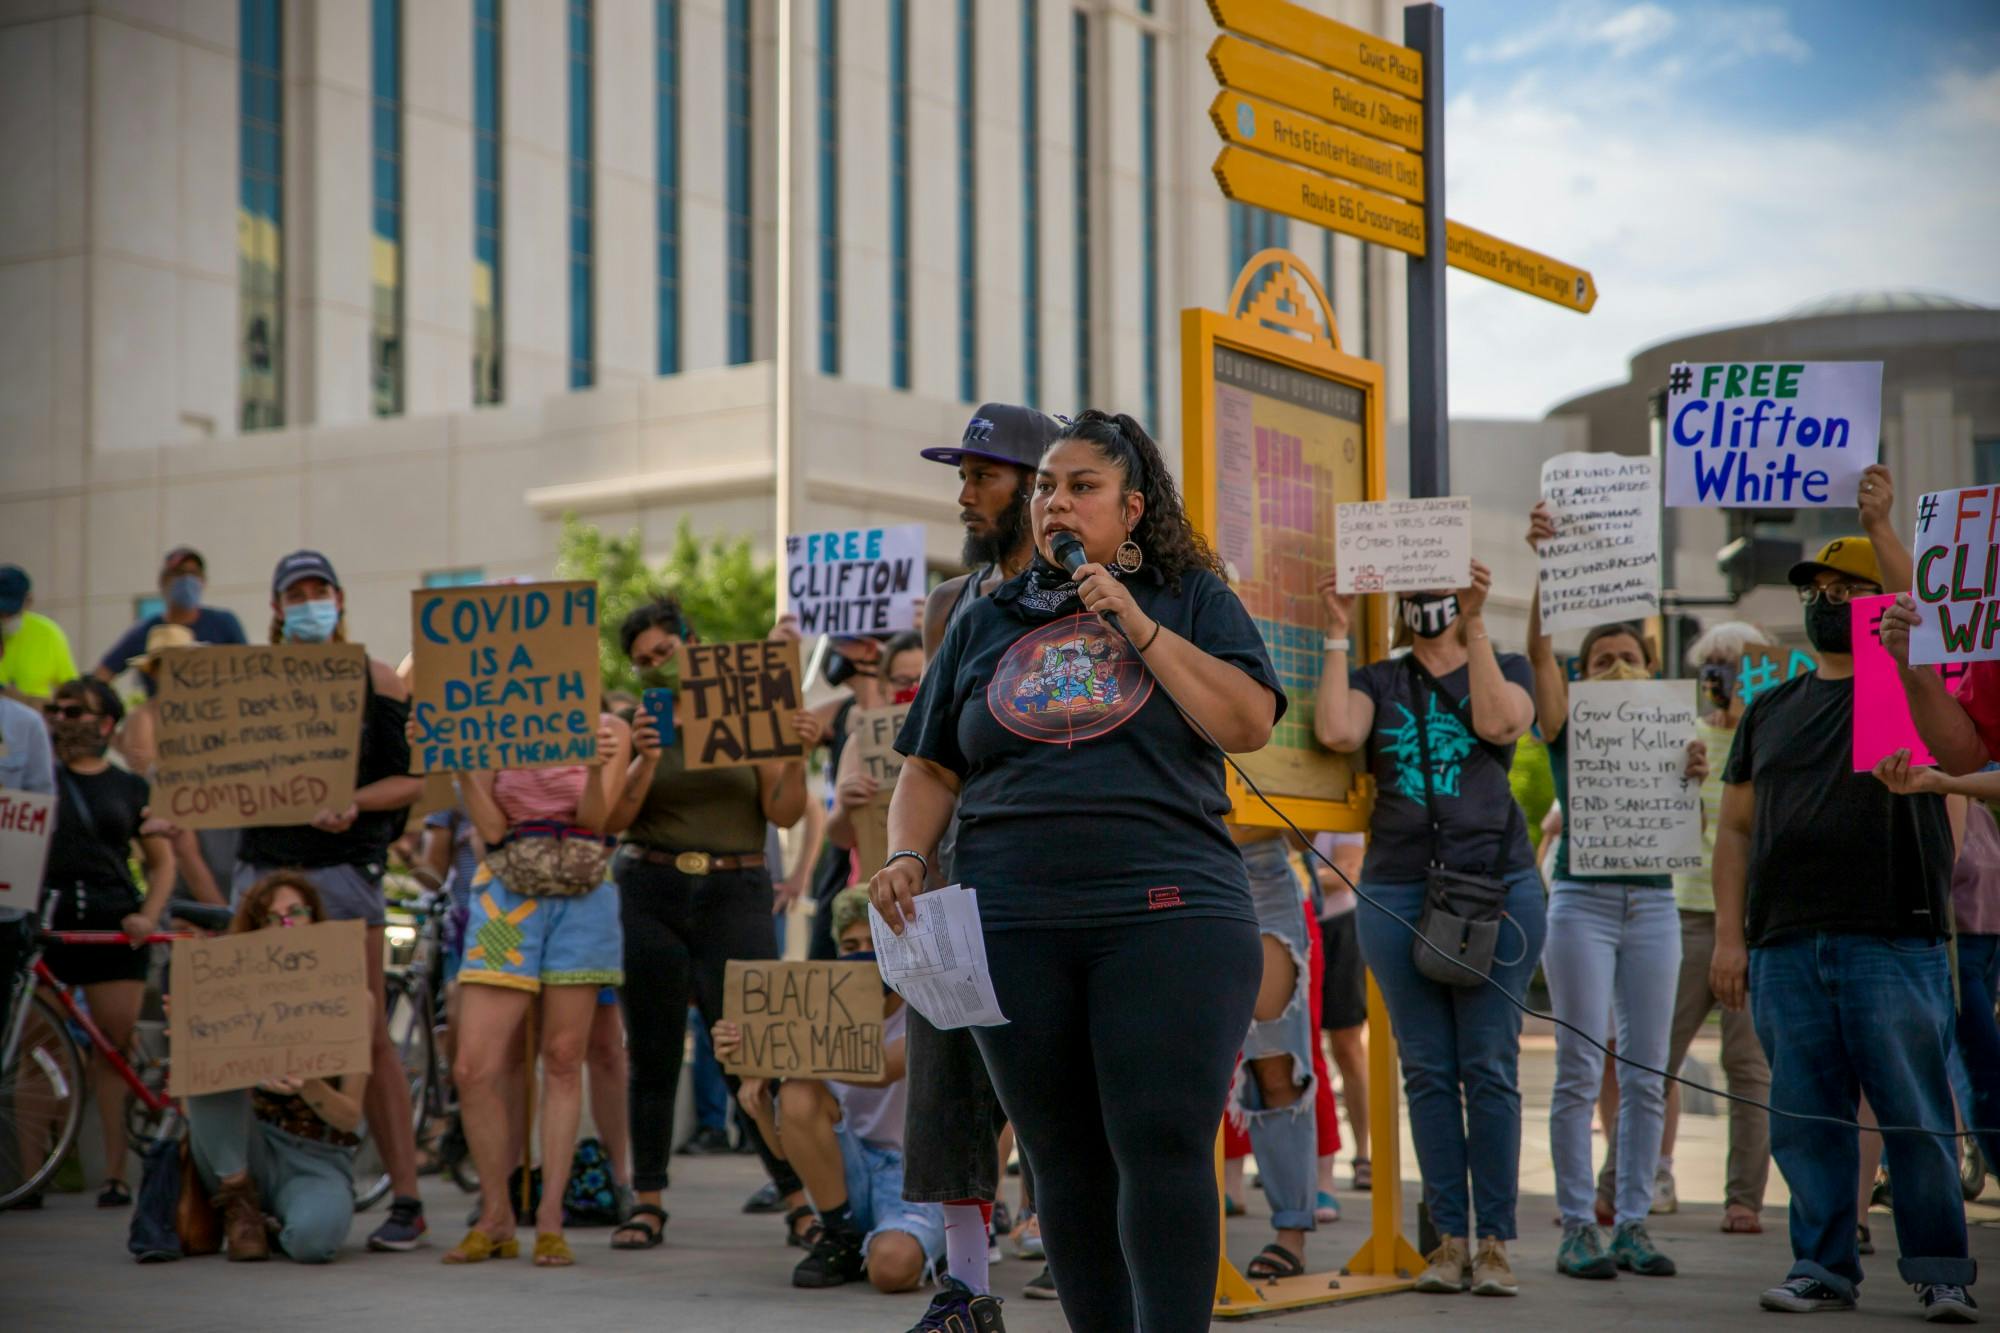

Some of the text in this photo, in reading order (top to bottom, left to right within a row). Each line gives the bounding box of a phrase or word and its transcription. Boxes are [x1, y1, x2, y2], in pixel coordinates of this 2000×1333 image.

[1359, 43, 1419, 85] Civic Plaza
[1332, 86, 1367, 119] Police
[1378, 103, 1419, 136] Sheriff
[1274, 119, 1301, 149] Arts
[1312, 132, 1393, 179] Entertainment
[1395, 161, 1418, 187] Dist
[1302, 184, 1421, 240] Route 66 Crossroads
[1447, 236, 1497, 267] ourthouse
[1500, 250, 1535, 287] Parking
[1538, 264, 1569, 297] Garage
[1672, 400, 1849, 448] Clifton
[1694, 450, 1829, 502] White
[1824, 540, 1844, 562] P
[789, 557, 913, 598] CLIFTON
[421, 586, 597, 645] COVID 19
[799, 597, 891, 633] WHITE
[1403, 595, 1457, 633] VOTE
[170, 653, 363, 689] KELLER RAISED
[471, 643, 534, 677] IS A
[688, 641, 787, 677] FREE
[445, 671, 585, 712] DEATH
[681, 669, 797, 719] THEM
[1572, 701, 1612, 723] Gov
[415, 702, 590, 743] Sentence
[701, 709, 802, 764] ALL
[1574, 728, 1624, 757] Mayor
[423, 743, 491, 772] FREE
[1574, 759, 1621, 773] JOIN
[171, 774, 328, 817] COMBINED
[1575, 776, 1664, 790] PROTEST
[0, 796, 48, 836] THEM
[1570, 796, 1696, 812] END SANCTION
[1573, 816, 1597, 831] OF
[1572, 833, 1659, 850] VIOLENCE
[743, 967, 854, 1030] BLACK
[811, 1023, 881, 1072] MATTER
